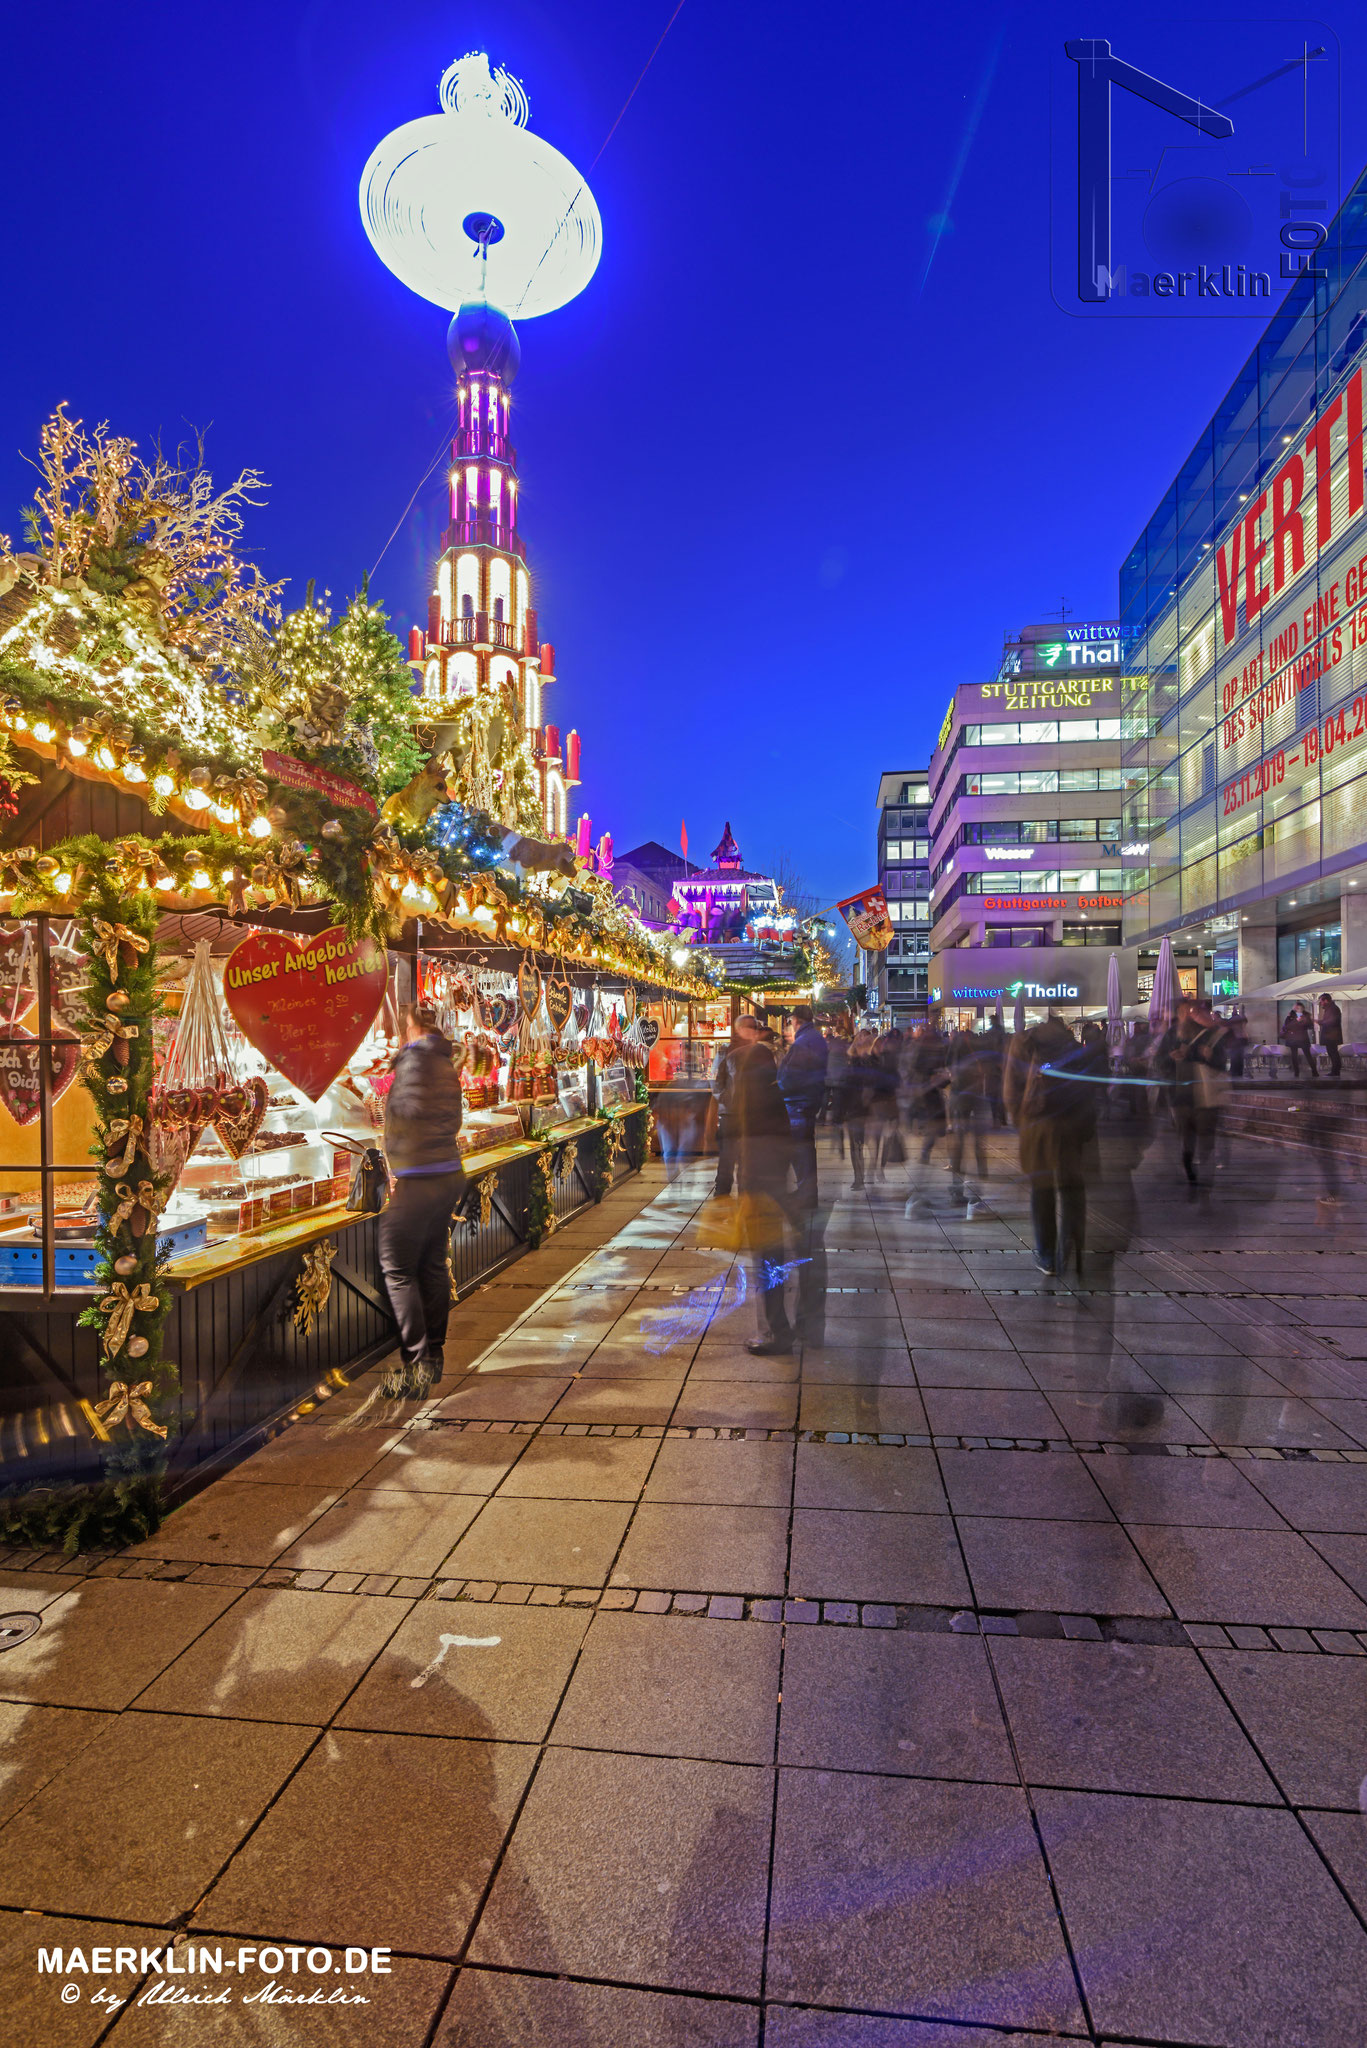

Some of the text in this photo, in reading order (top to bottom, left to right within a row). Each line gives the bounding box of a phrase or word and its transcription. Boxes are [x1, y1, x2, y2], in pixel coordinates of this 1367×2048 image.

[1223, 676, 1238, 714] OP
[1242, 650, 1265, 701] ART
[1269, 622, 1299, 675] UND
[1303, 581, 1340, 647] EINE
[981, 678, 1113, 698] STUTTGARTER
[1005, 693, 1091, 710] ZEITUNG
[1224, 707, 1245, 751] DES
[1250, 626, 1343, 730] SCHWINDELS
[1223, 749, 1285, 817] 23.11.2019
[984, 896, 1068, 911] Stuttgarter
[228, 960, 280, 989] Unser
[324, 953, 383, 986] heute!
[952, 986, 1004, 998] wittwer
[1024, 984, 1078, 998] Thalia
